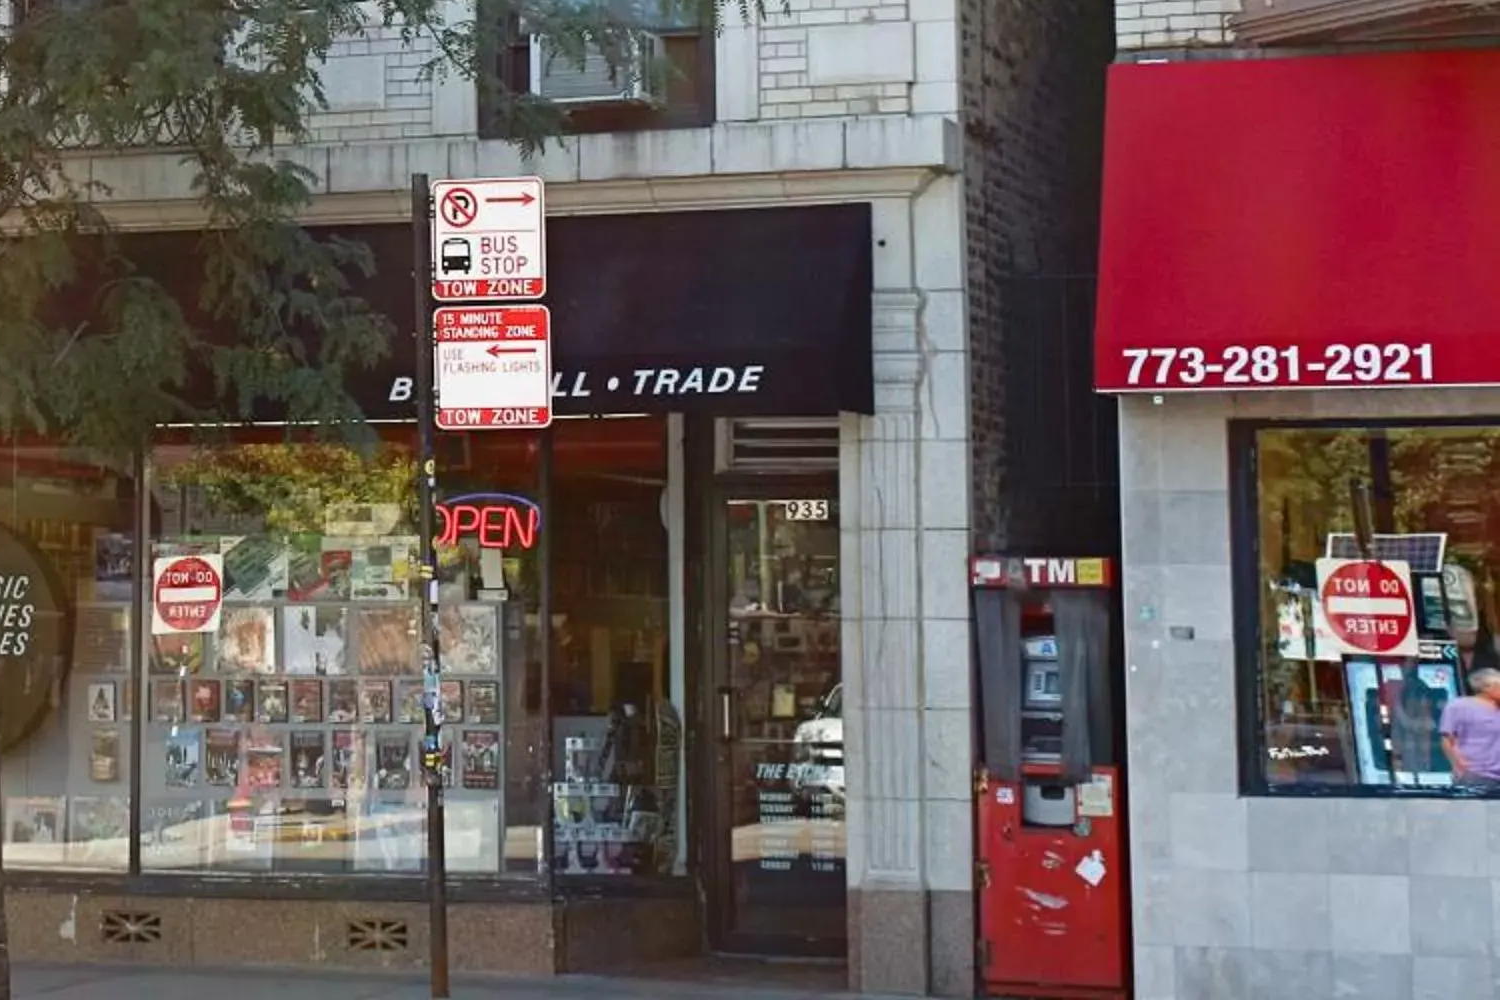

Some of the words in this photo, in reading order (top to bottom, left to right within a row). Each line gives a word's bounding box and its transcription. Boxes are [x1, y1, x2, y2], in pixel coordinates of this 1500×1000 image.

[481, 236, 518, 253] BUS
[481, 256, 528, 275] STOP
[441, 282, 477, 296] TOW
[488, 280, 533, 295] ZONE
[443, 313, 455, 325] 15
[460, 311, 503, 324] MINUTE
[443, 326, 499, 338] STANDING
[506, 325, 537, 337] ZONE
[443, 348, 464, 360] USE
[443, 361, 497, 374] FLASHING
[502, 360, 541, 373] LIGHTS
[1122, 343, 1434, 385] 773-281-2921
[552, 371, 592, 397] LL
[632, 366, 764, 394] TRADE
[443, 410, 481, 424] TOW
[491, 409, 540, 423] ZONE
[787, 501, 826, 519] 935
[756, 763, 786, 779] THE
